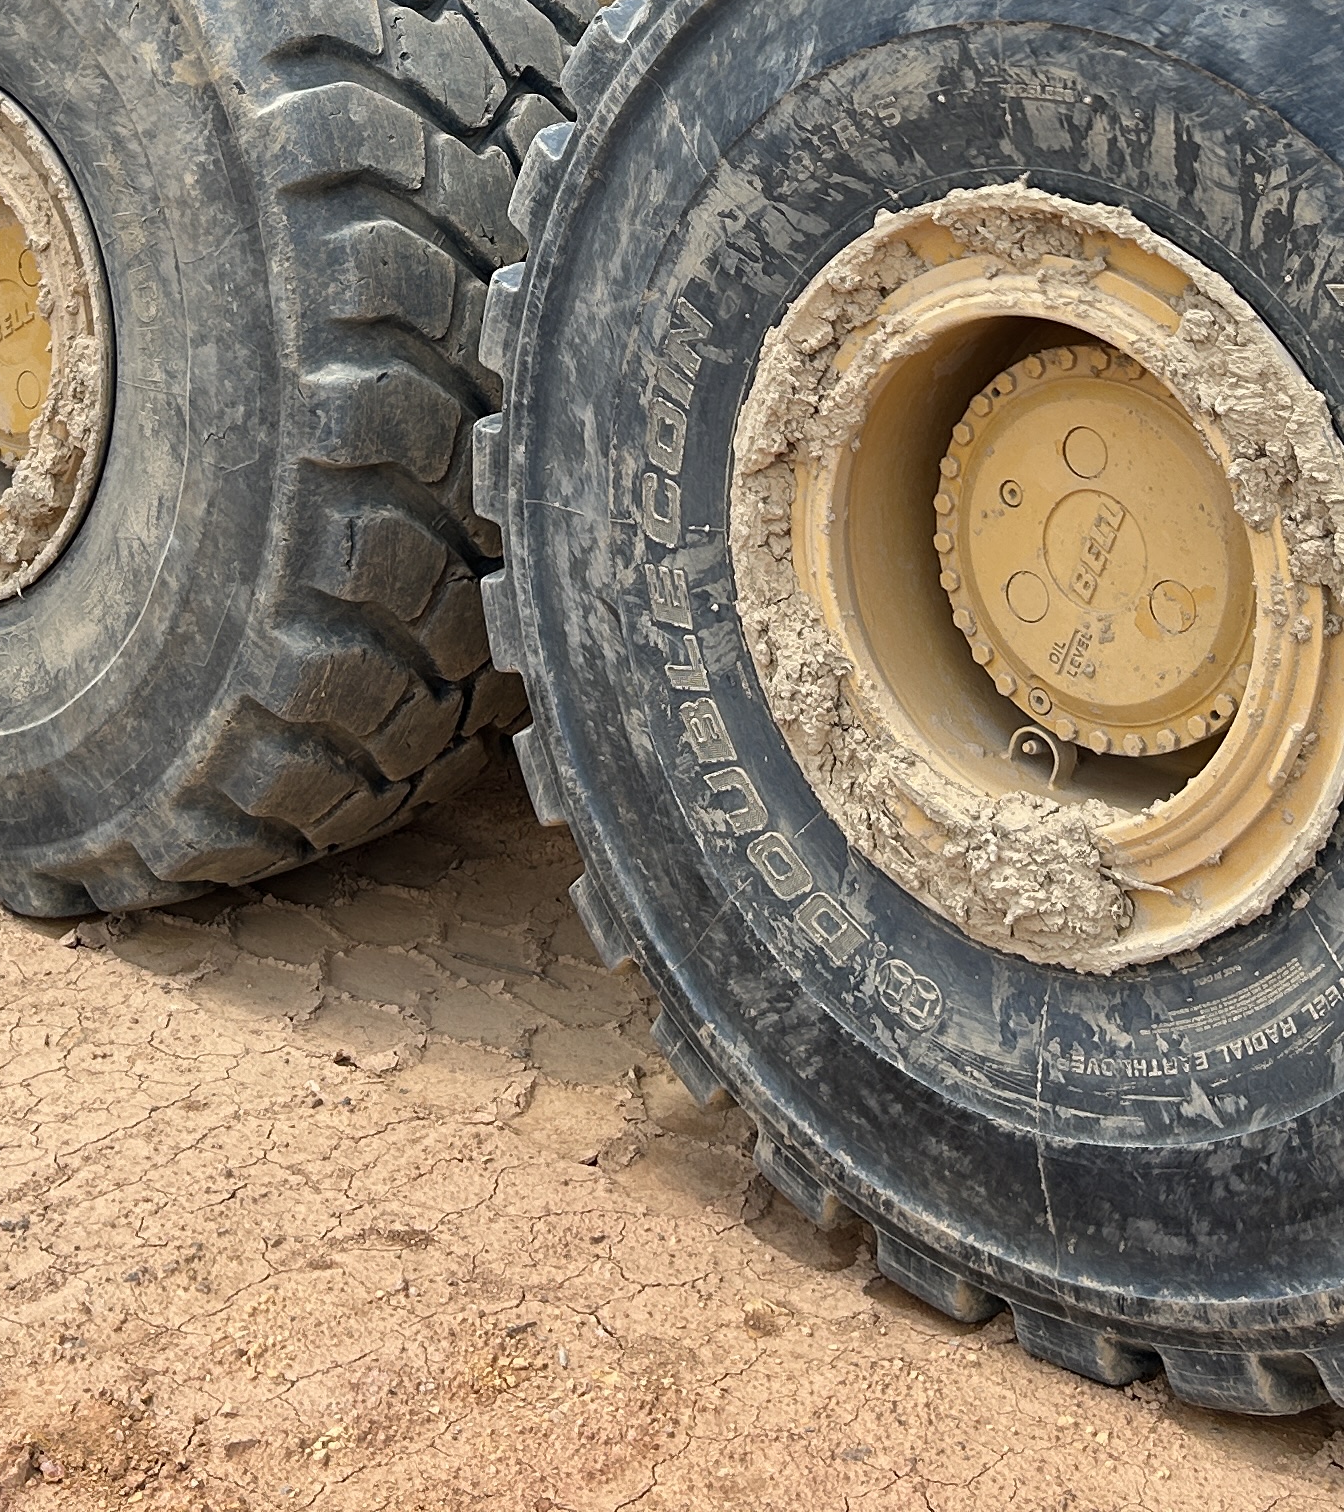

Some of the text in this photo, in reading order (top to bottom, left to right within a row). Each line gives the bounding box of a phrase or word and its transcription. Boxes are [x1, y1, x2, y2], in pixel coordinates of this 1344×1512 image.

[1070, 502, 1126, 605] BELL
[642, 296, 870, 966] DOUBLE COIN
[1049, 641, 1066, 664] OIL
[1066, 633, 1093, 678] LEVEL
[1223, 1016, 1298, 1063] RADIAL
